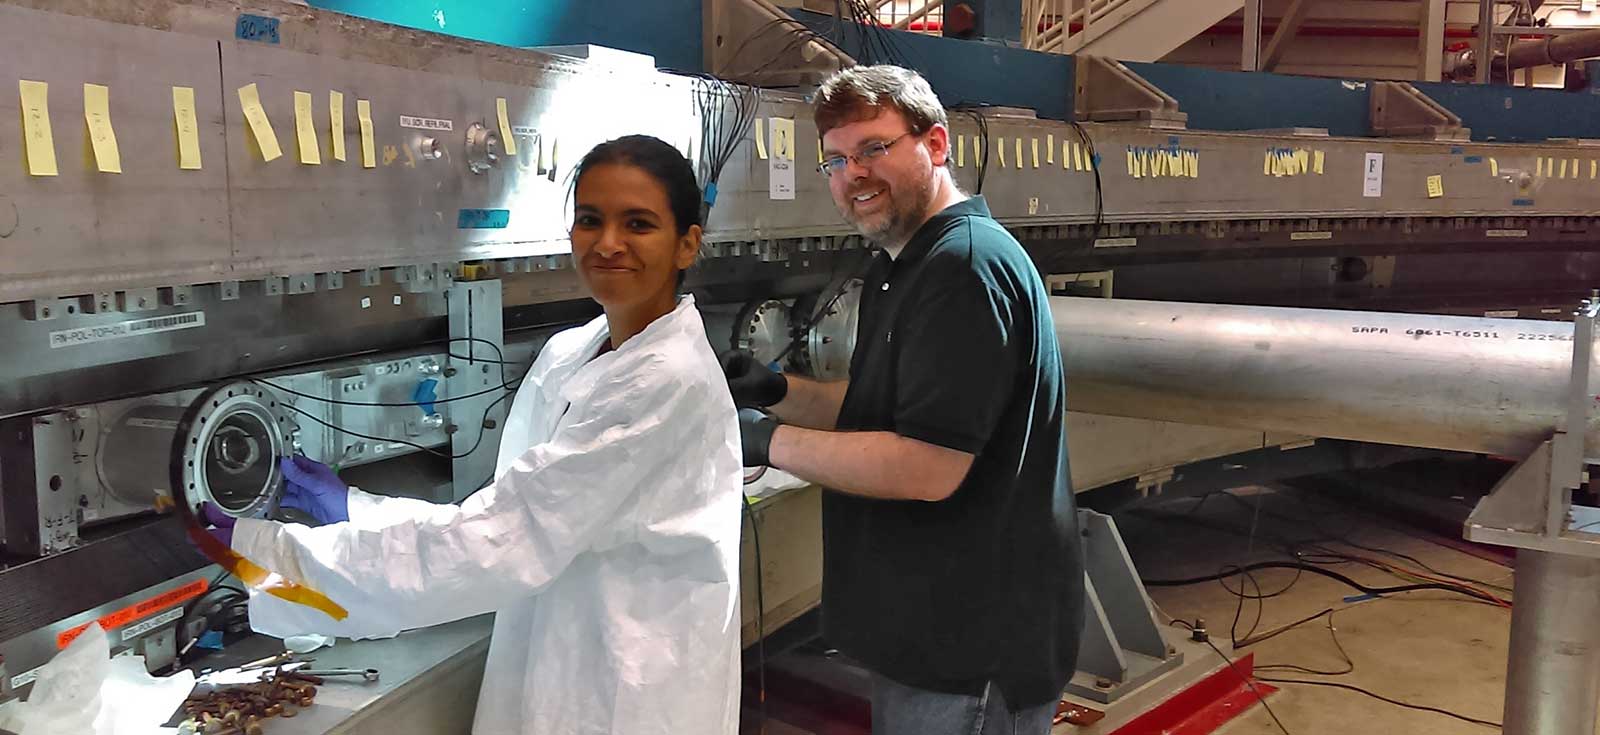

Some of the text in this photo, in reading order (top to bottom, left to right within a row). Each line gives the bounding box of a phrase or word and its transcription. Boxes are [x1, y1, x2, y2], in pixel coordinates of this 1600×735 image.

[1369, 158, 1377, 173] F
[1351, 326, 1389, 334] SAPA
[1405, 328, 1500, 338] 6061-T6511
